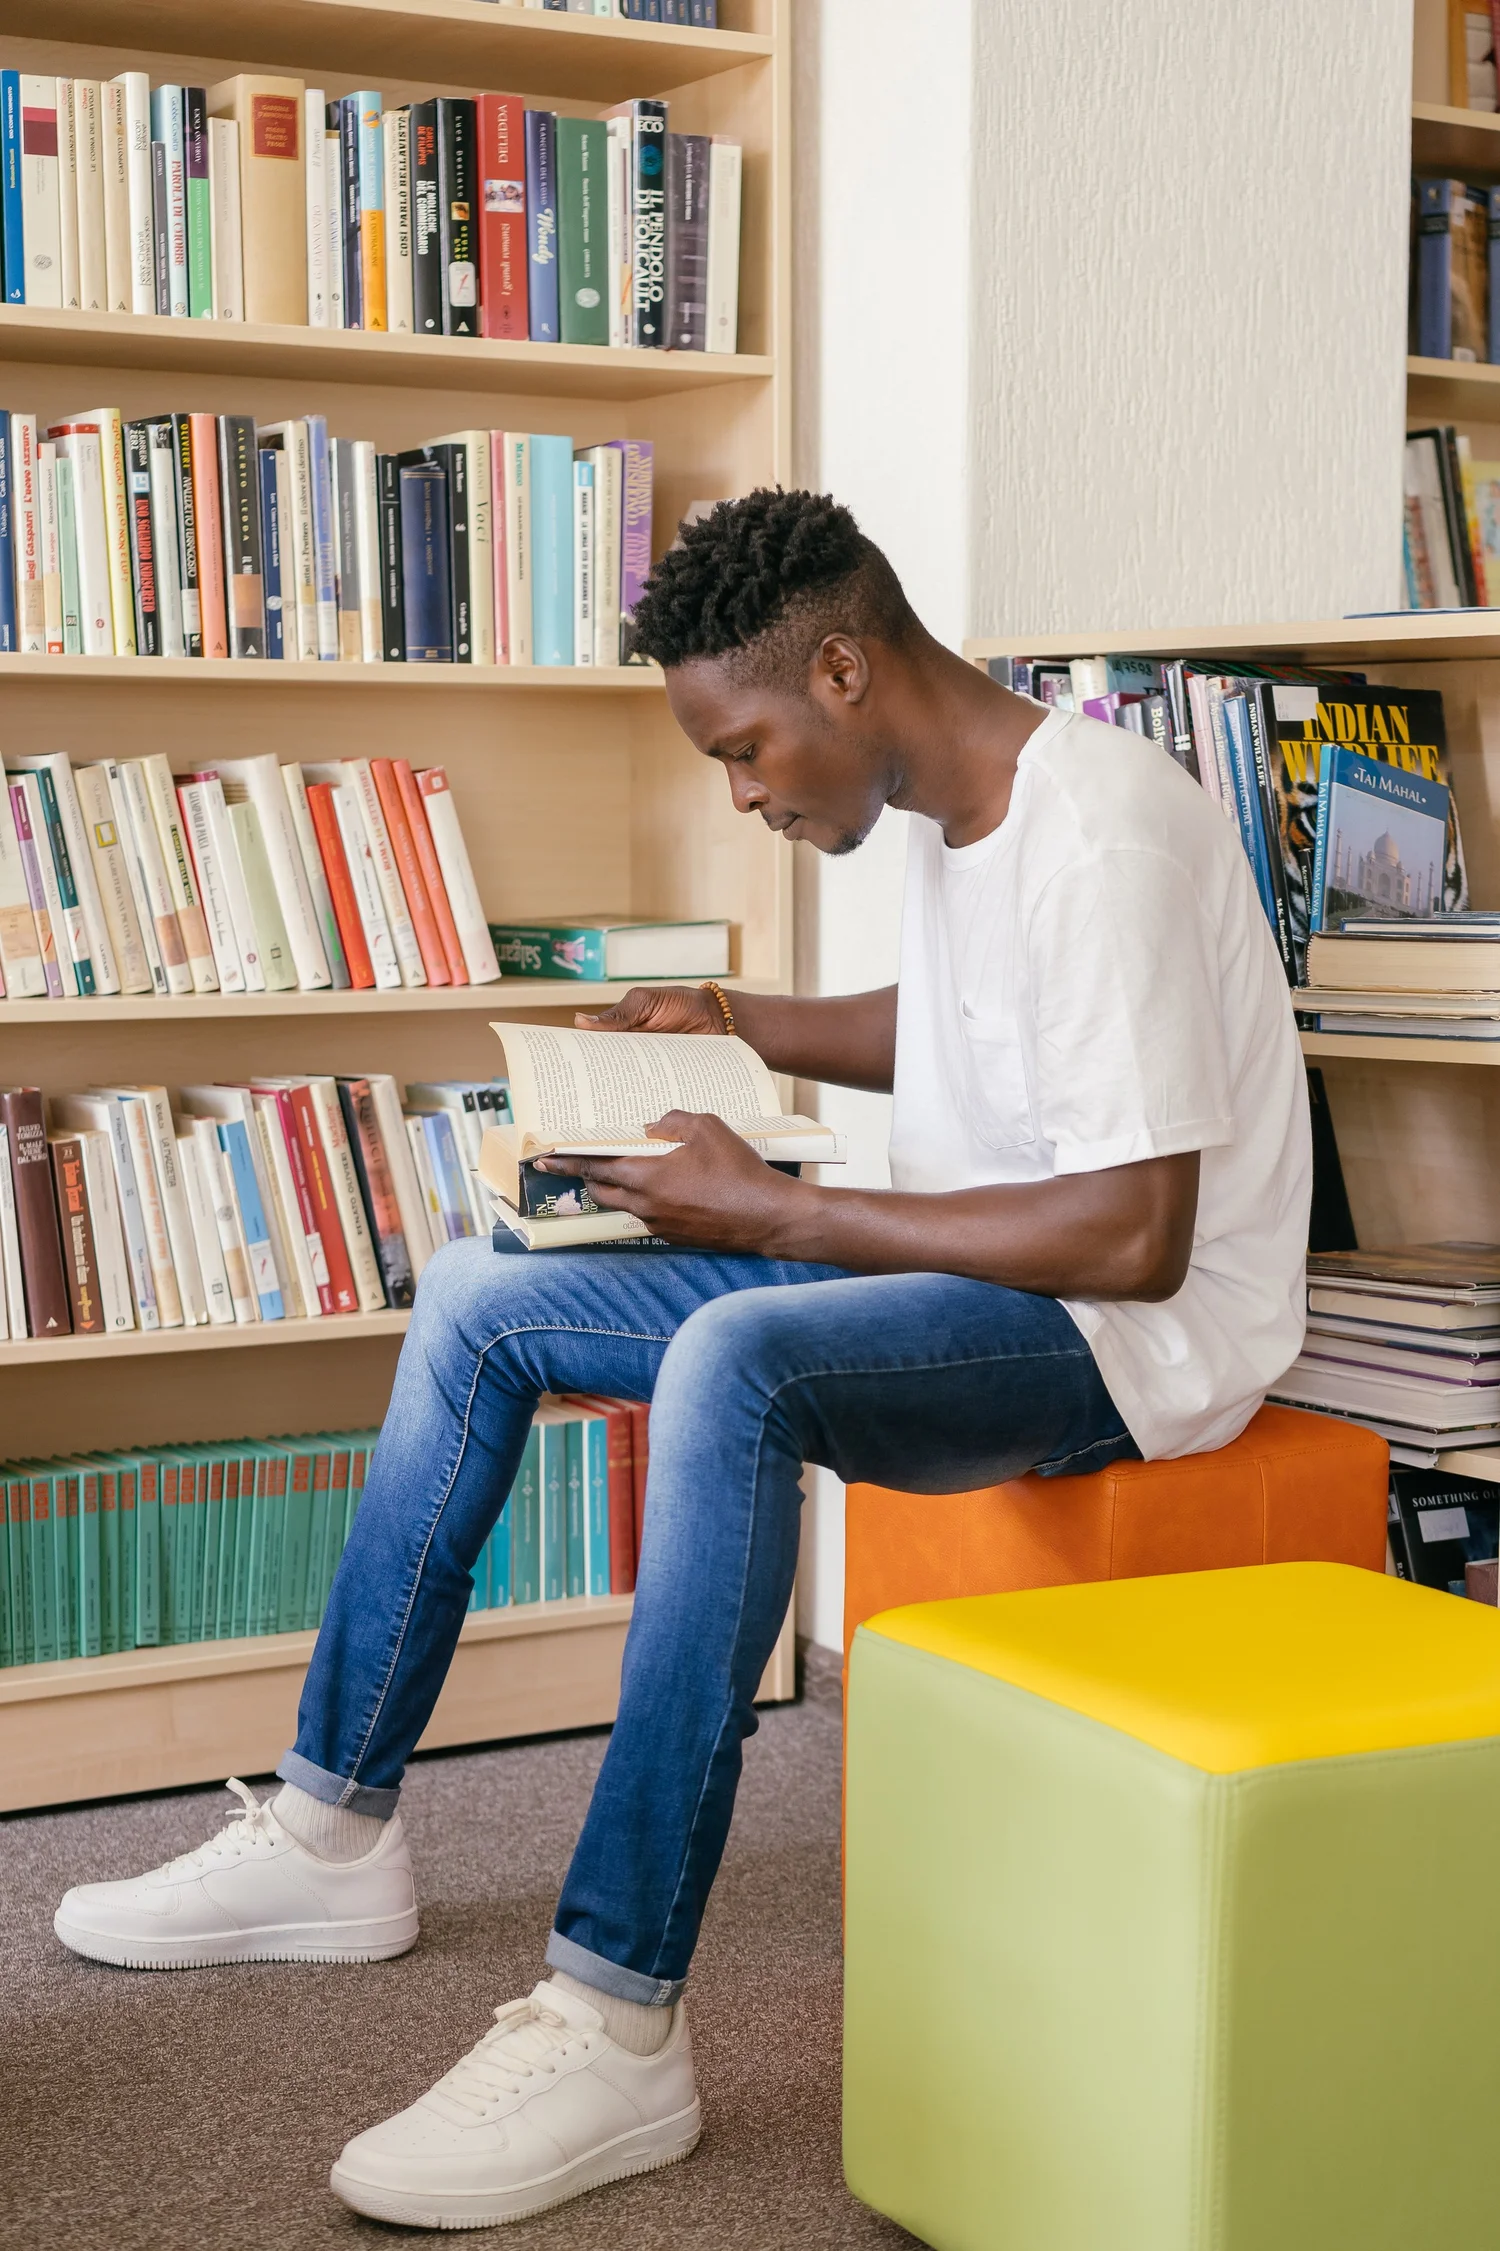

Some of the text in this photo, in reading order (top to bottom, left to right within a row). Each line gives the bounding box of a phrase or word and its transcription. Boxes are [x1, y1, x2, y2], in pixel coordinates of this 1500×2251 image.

[192, 108, 202, 163] ADRIANO CIOCI
[417, 126, 426, 166] DE FILIPPIS
[426, 126, 434, 149] CARLO
[498, 104, 509, 163] DELEDDA
[539, 123, 547, 165] FRANCESCA
[636, 121, 664, 133] ECO
[90, 164, 96, 172] LE
[397, 116, 408, 257] COSÌ PARLÒ BELLAVISTA
[171, 160, 185, 267] PAROLA DI GIOBBE
[416, 180, 428, 255] DEL COMMISSARIO
[427, 181, 437, 234] LE MOLLICHE
[370, 211, 379, 267] LA DISTRAZIONE
[500, 223, 513, 290] grandi romanzi
[532, 208, 555, 264] Wondy
[635, 189, 650, 312] DI FOUCAULT
[648, 190, 664, 302] IL PENDOLO
[112, 418, 123, 485] EZIO GREGGIO
[130, 430, 138, 451] ZERI
[180, 423, 190, 469] OLIVIERI
[22, 425, 32, 503] L'uovo azzurro
[237, 427, 250, 542] ALBERTO LEDDA
[297, 438, 308, 508] colore del destino
[516, 443, 524, 486] Marenco
[116, 503, 124, 516] LUI
[183, 476, 197, 577] MALEDETTO FERRAGOSTO
[475, 501, 489, 544] Voci
[24, 510, 36, 580] uigi Gasparri
[118, 528, 127, 550] NON
[136, 499, 156, 612] UNO SGUARDO INDISCRETO
[241, 556, 252, 564] IL
[301, 522, 310, 555] Fruttero
[120, 560, 128, 575] LUI
[1151, 706, 1166, 749] Bolly
[1207, 700, 1225, 740] Mystical
[1303, 702, 1411, 744] INDIAN
[1214, 740, 1228, 766] Rites
[1247, 703, 1268, 788] INDIAN WILD LIFE
[1218, 764, 1230, 783] and
[1231, 752, 1253, 827] ARCHITECTURE
[1357, 766, 1422, 804] TAJ MAHAL
[358, 768, 392, 871] ROMA SETTEMBRE
[1316, 779, 1329, 839] TAJ MAHAL
[171, 830, 194, 906] COMPITI DELLE VACAN
[1311, 848, 1323, 918] BIKRAM GREWAL
[16, 1130, 44, 1140] TOMIZZA
[18, 1124, 40, 1133] FULVIO
[18, 1140, 44, 1151] IL MALE
[22, 1147, 42, 1156] VIENE
[17, 1152, 48, 1165] DAL NORD
[160, 1137, 178, 1188] LA MAZZETTA
[339, 1151, 365, 1236] RENATO OLIVIERI
[580, 1187, 590, 1213] ORTUNA
[1412, 1492, 1479, 1507] SOMETHING
